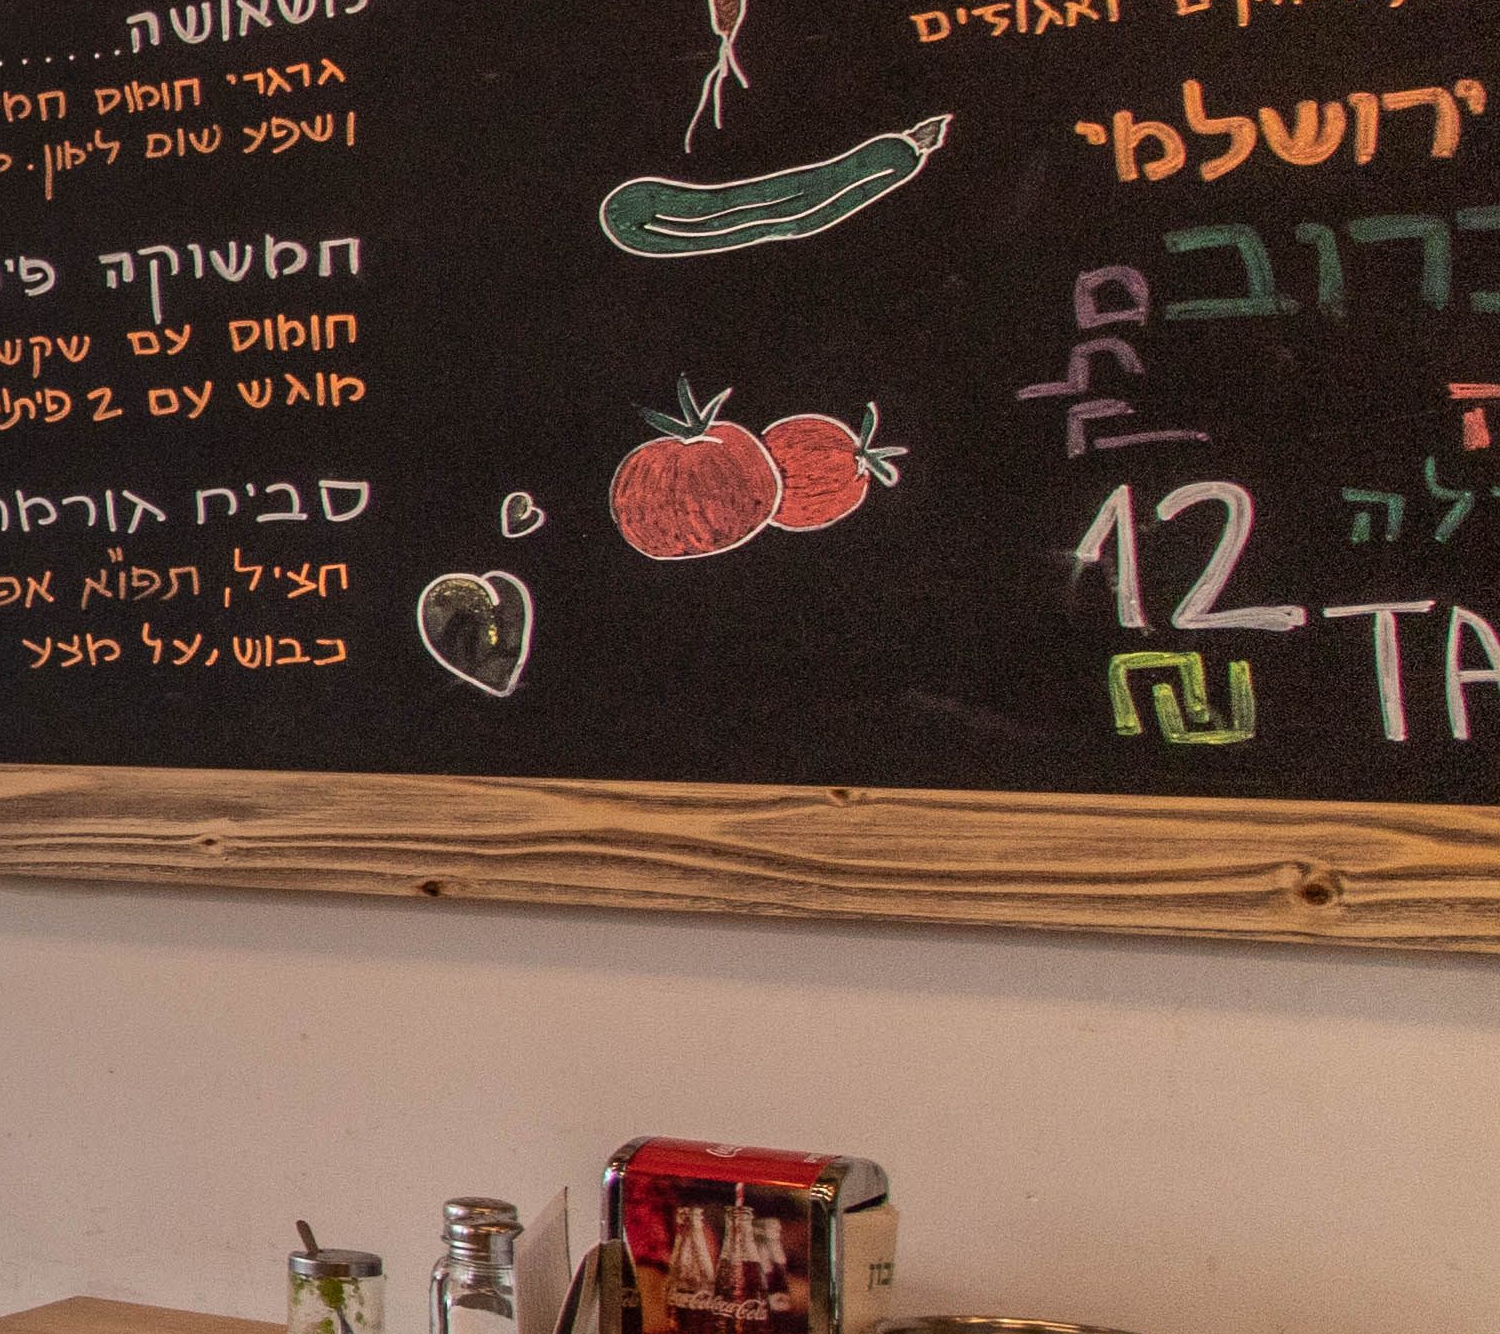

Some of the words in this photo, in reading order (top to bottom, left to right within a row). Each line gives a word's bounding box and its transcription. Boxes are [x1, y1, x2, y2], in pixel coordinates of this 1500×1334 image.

[94, 77, 201, 115] חומוס
[226, 58, 346, 96] גרגרי
[145, 124, 222, 159] שום
[243, 111, 356, 154] ושפע
[1075, 79, 1486, 181] ירושלמי
[99, 234, 361, 326] חמשוקה
[228, 313, 357, 352] חומוס
[148, 380, 213, 419] עם
[237, 372, 366, 409] מוגש
[196, 479, 371, 525] סביח
[1077, 482, 1306, 632] 12
[22, 633, 122, 669] מצע
[141, 622, 203, 666] על
